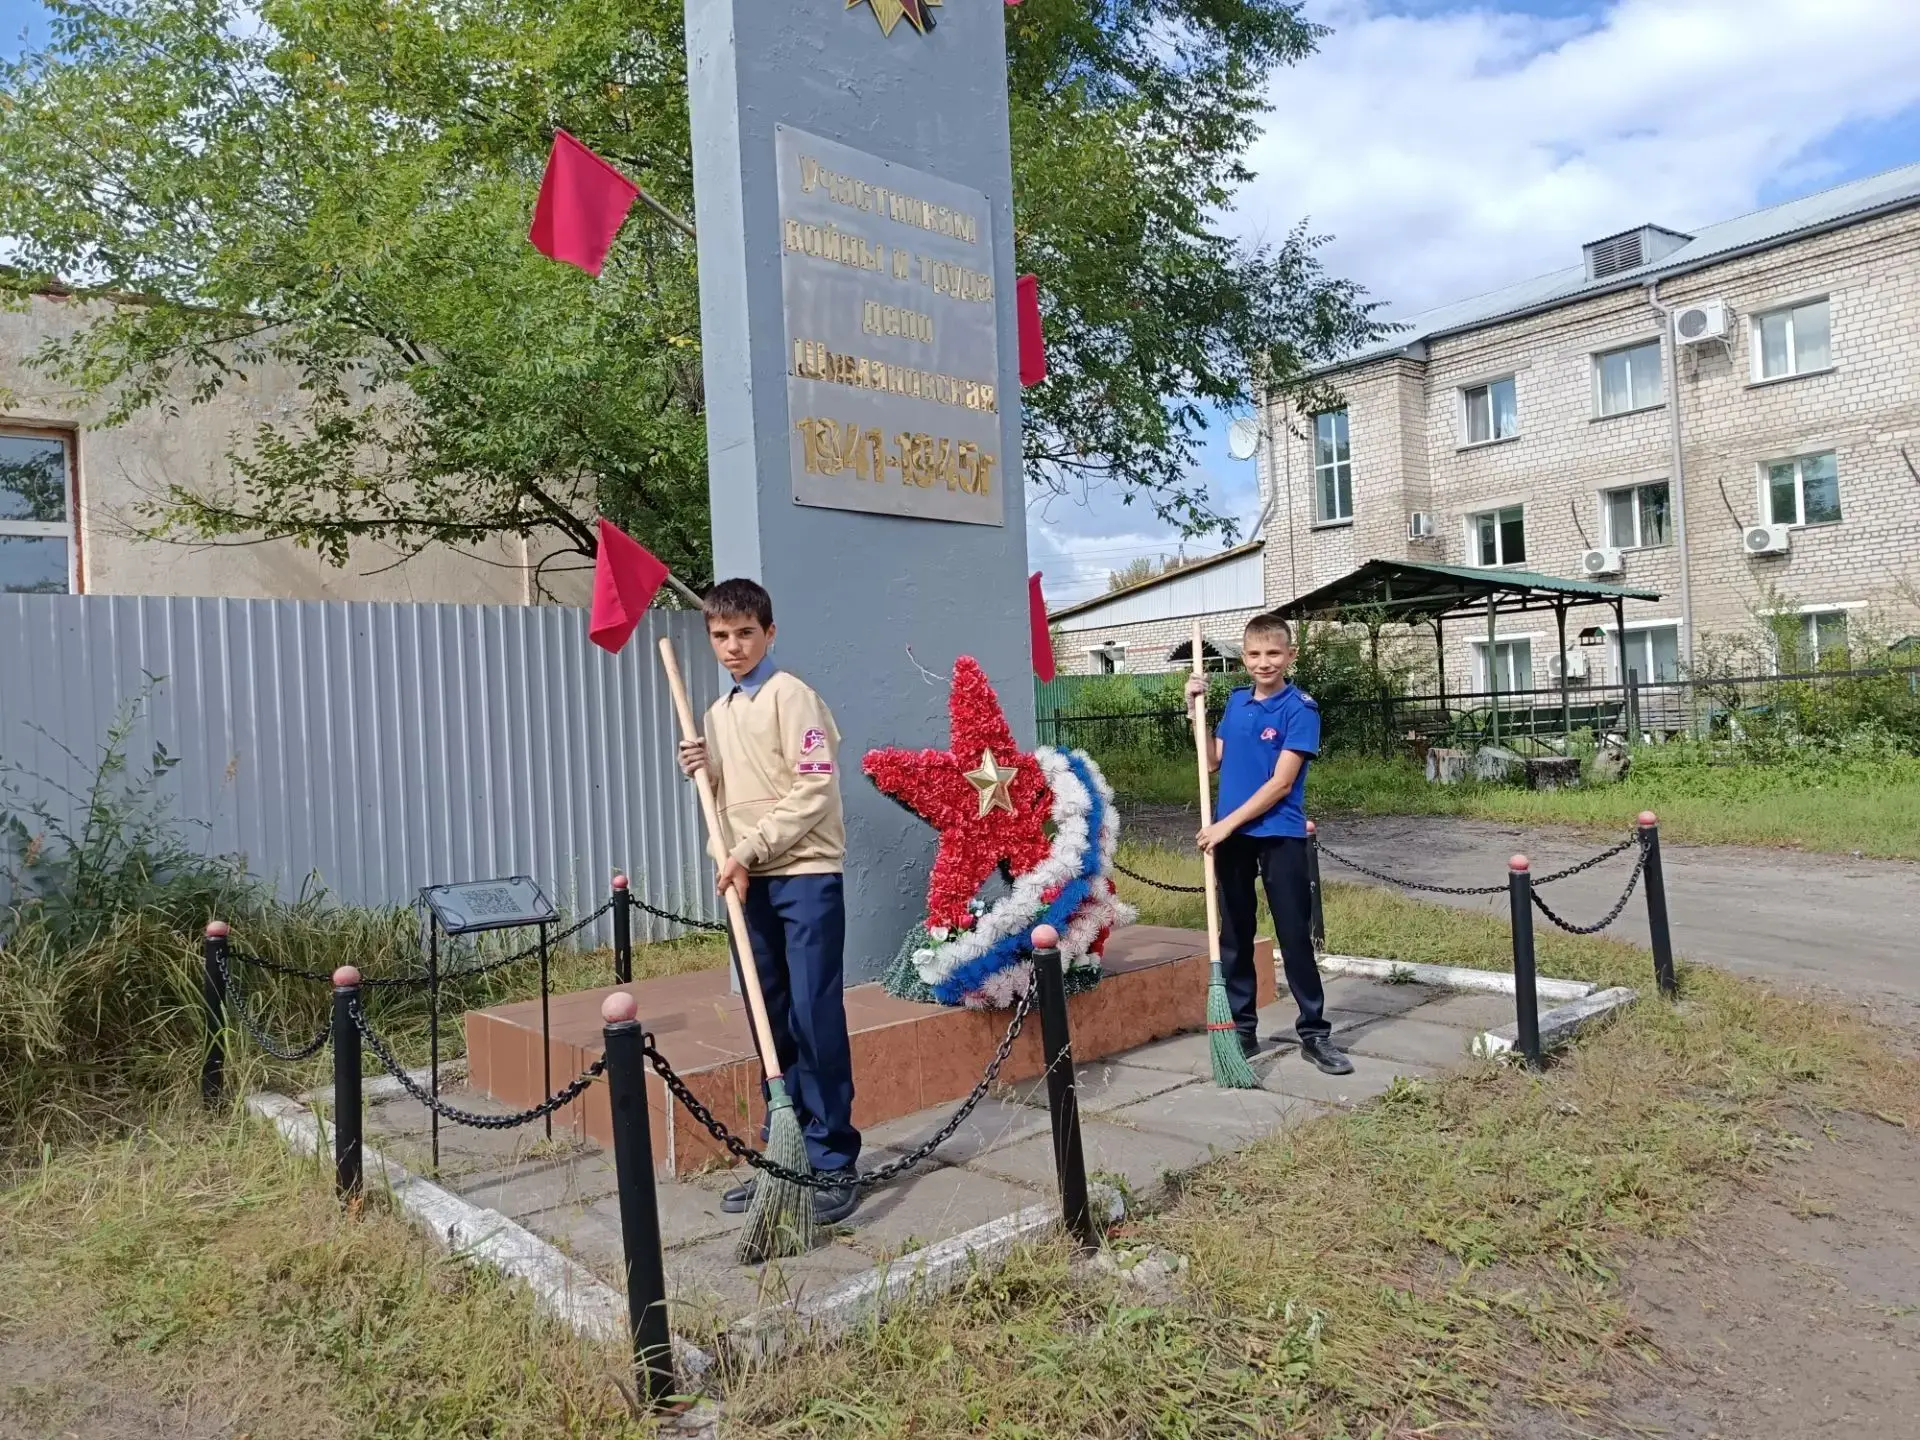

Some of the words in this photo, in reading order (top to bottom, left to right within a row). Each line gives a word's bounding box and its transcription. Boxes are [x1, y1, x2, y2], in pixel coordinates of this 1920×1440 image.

[799, 154, 976, 243] Участникам
[785, 218, 884, 273] войны
[892, 248, 909, 280] и
[915, 254, 994, 303] труда
[861, 298, 933, 343] депо
[794, 337, 995, 413] Шимановская
